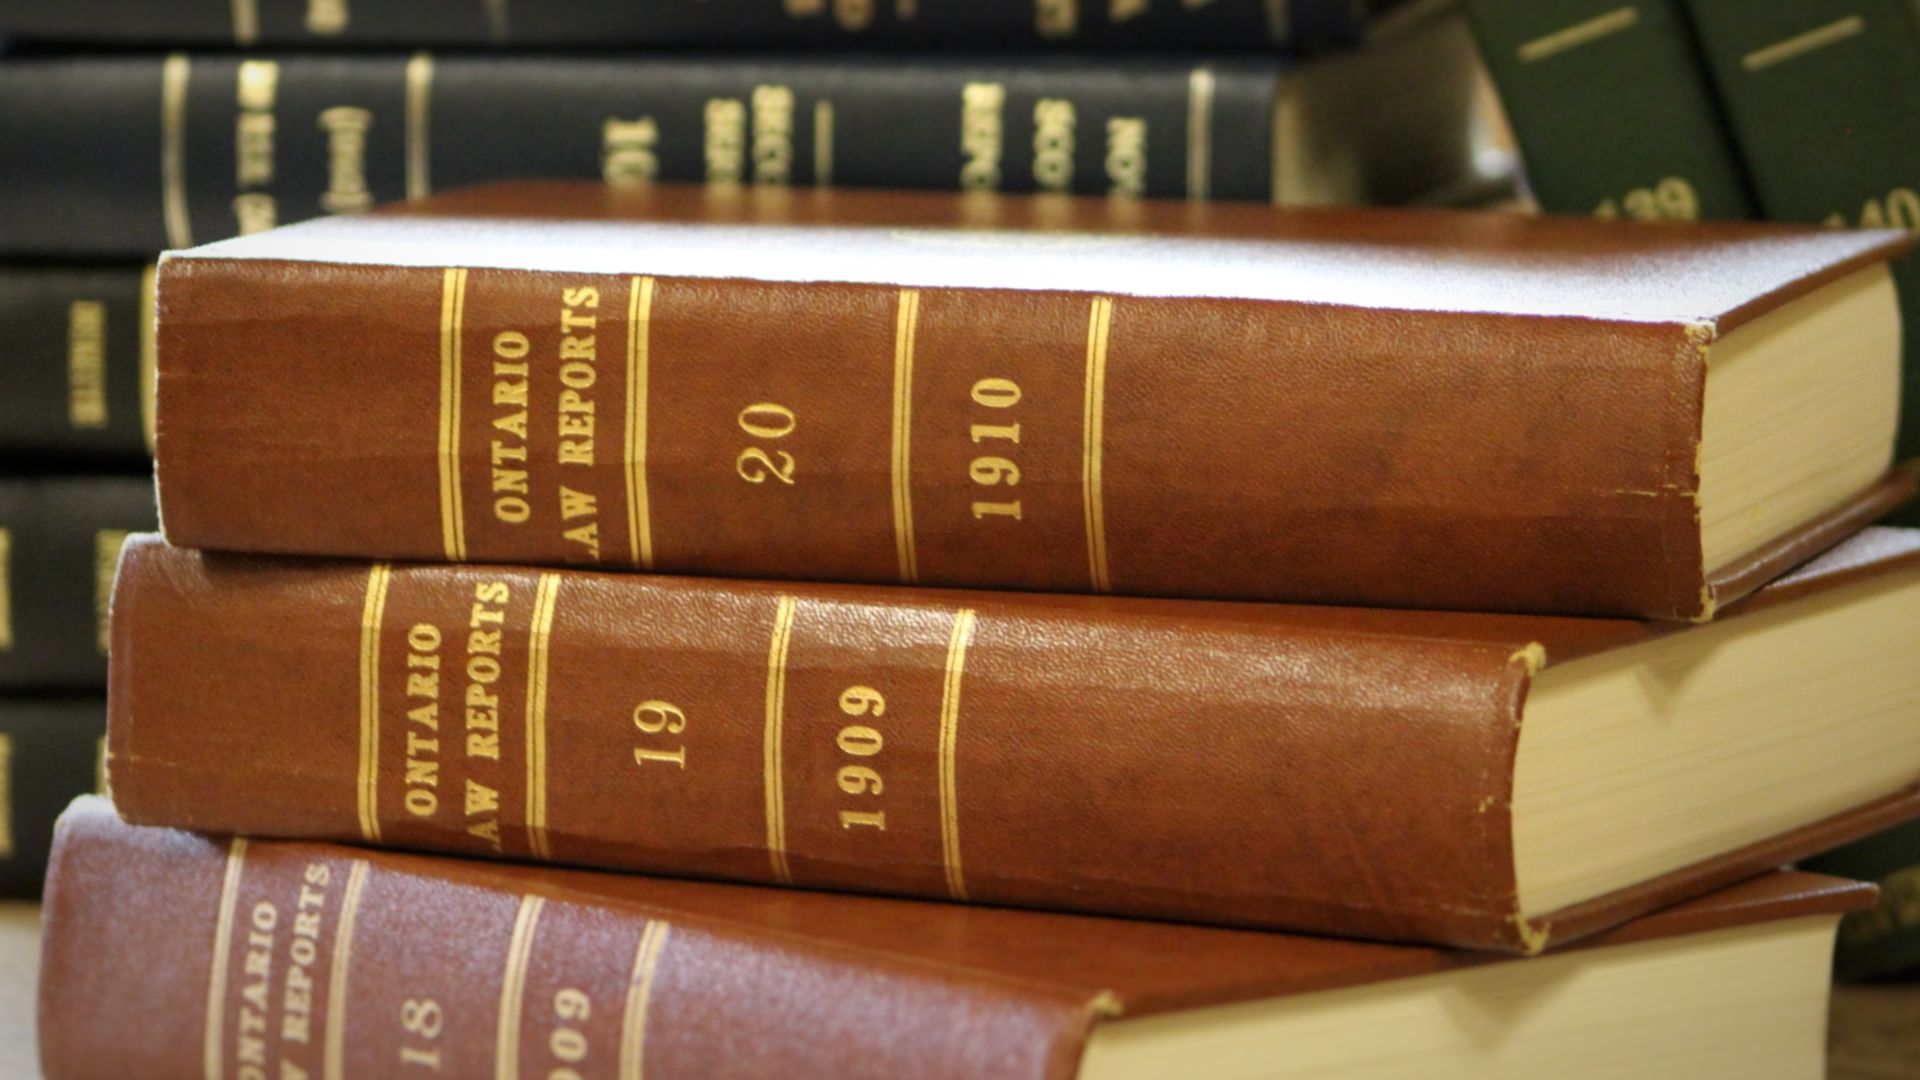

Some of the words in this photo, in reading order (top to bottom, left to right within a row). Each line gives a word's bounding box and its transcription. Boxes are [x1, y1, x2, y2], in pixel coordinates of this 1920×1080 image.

[492, 331, 530, 523] ONTARIO
[559, 284, 600, 465] REPORTS
[737, 402, 796, 485] 20
[969, 377, 1022, 520] 1910
[404, 622, 442, 817] ONTARIO
[465, 580, 509, 760] REPORTS
[633, 699, 686, 770] 19
[465, 780, 500, 849] AW
[836, 685, 886, 831] 1909
[281, 862, 331, 1045] REPORTS
[400, 998, 443, 1069] 18
